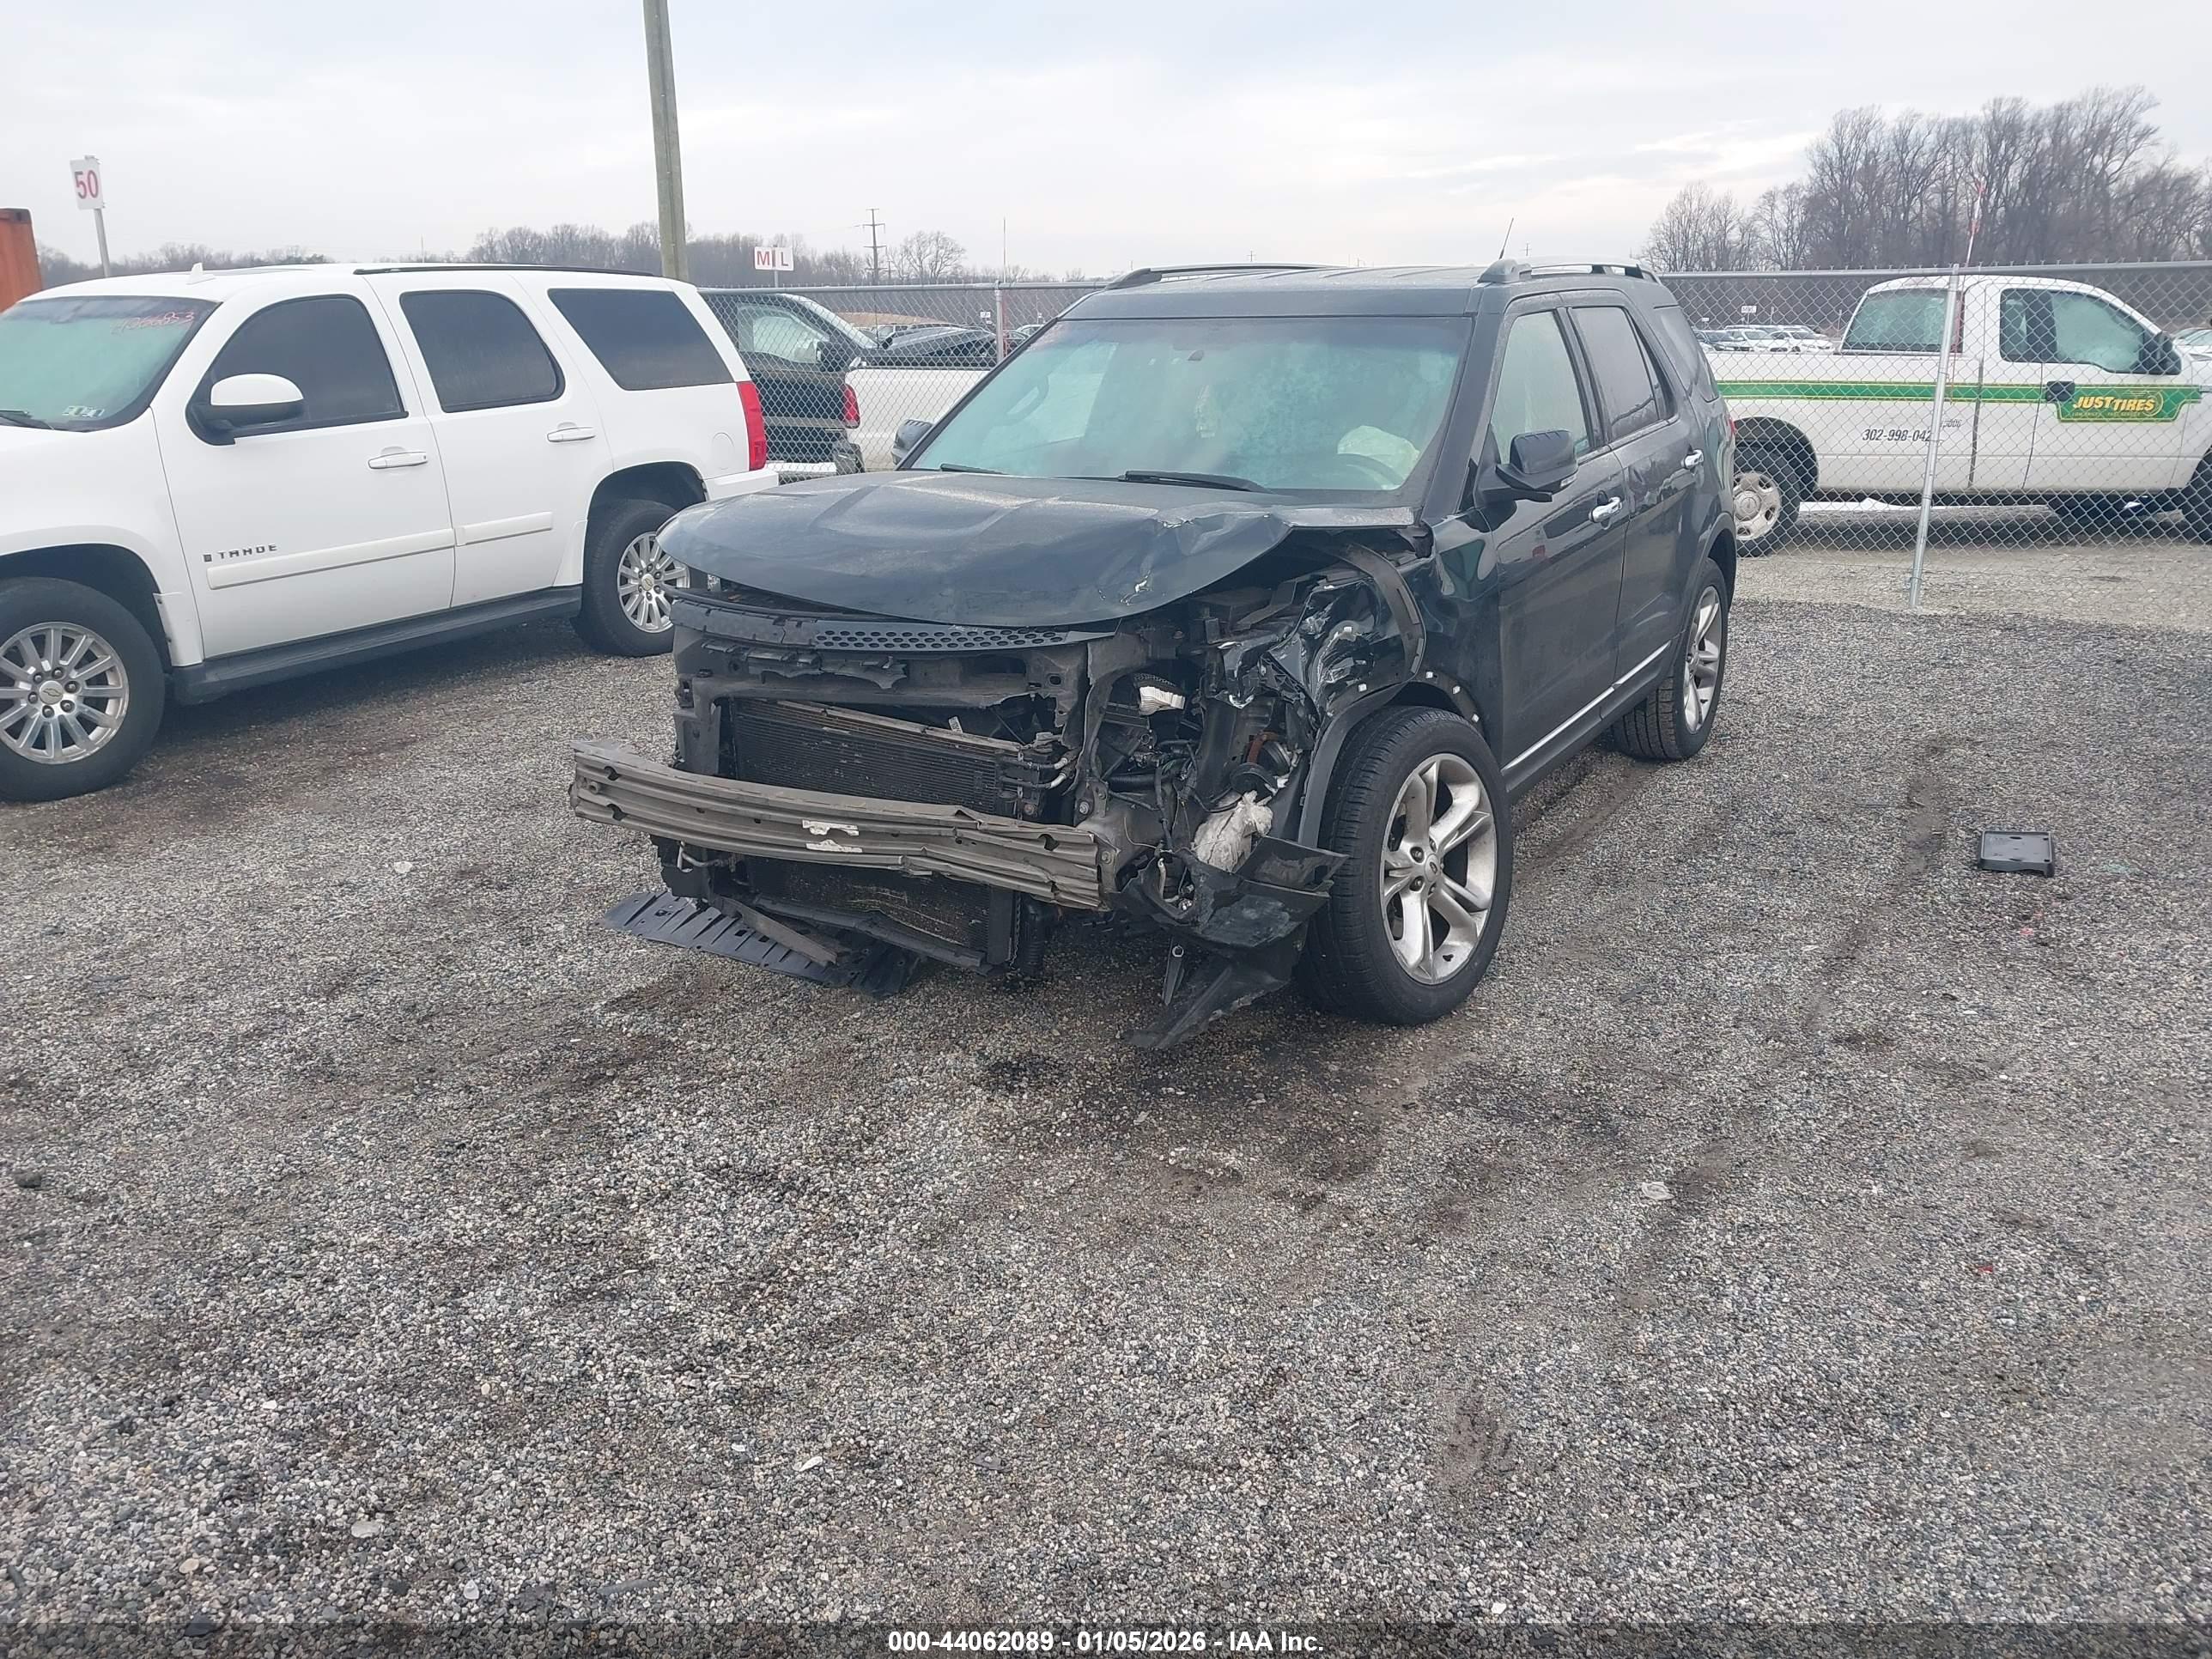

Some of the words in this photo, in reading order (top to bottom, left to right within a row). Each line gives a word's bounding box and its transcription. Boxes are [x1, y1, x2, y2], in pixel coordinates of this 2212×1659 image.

[74, 170, 99, 199] 50
[2072, 396, 2114, 409] JUST
[2112, 398, 2155, 411] TIRES
[1862, 428, 1932, 441] 302-998-042
[216, 544, 278, 560] TAHOE
